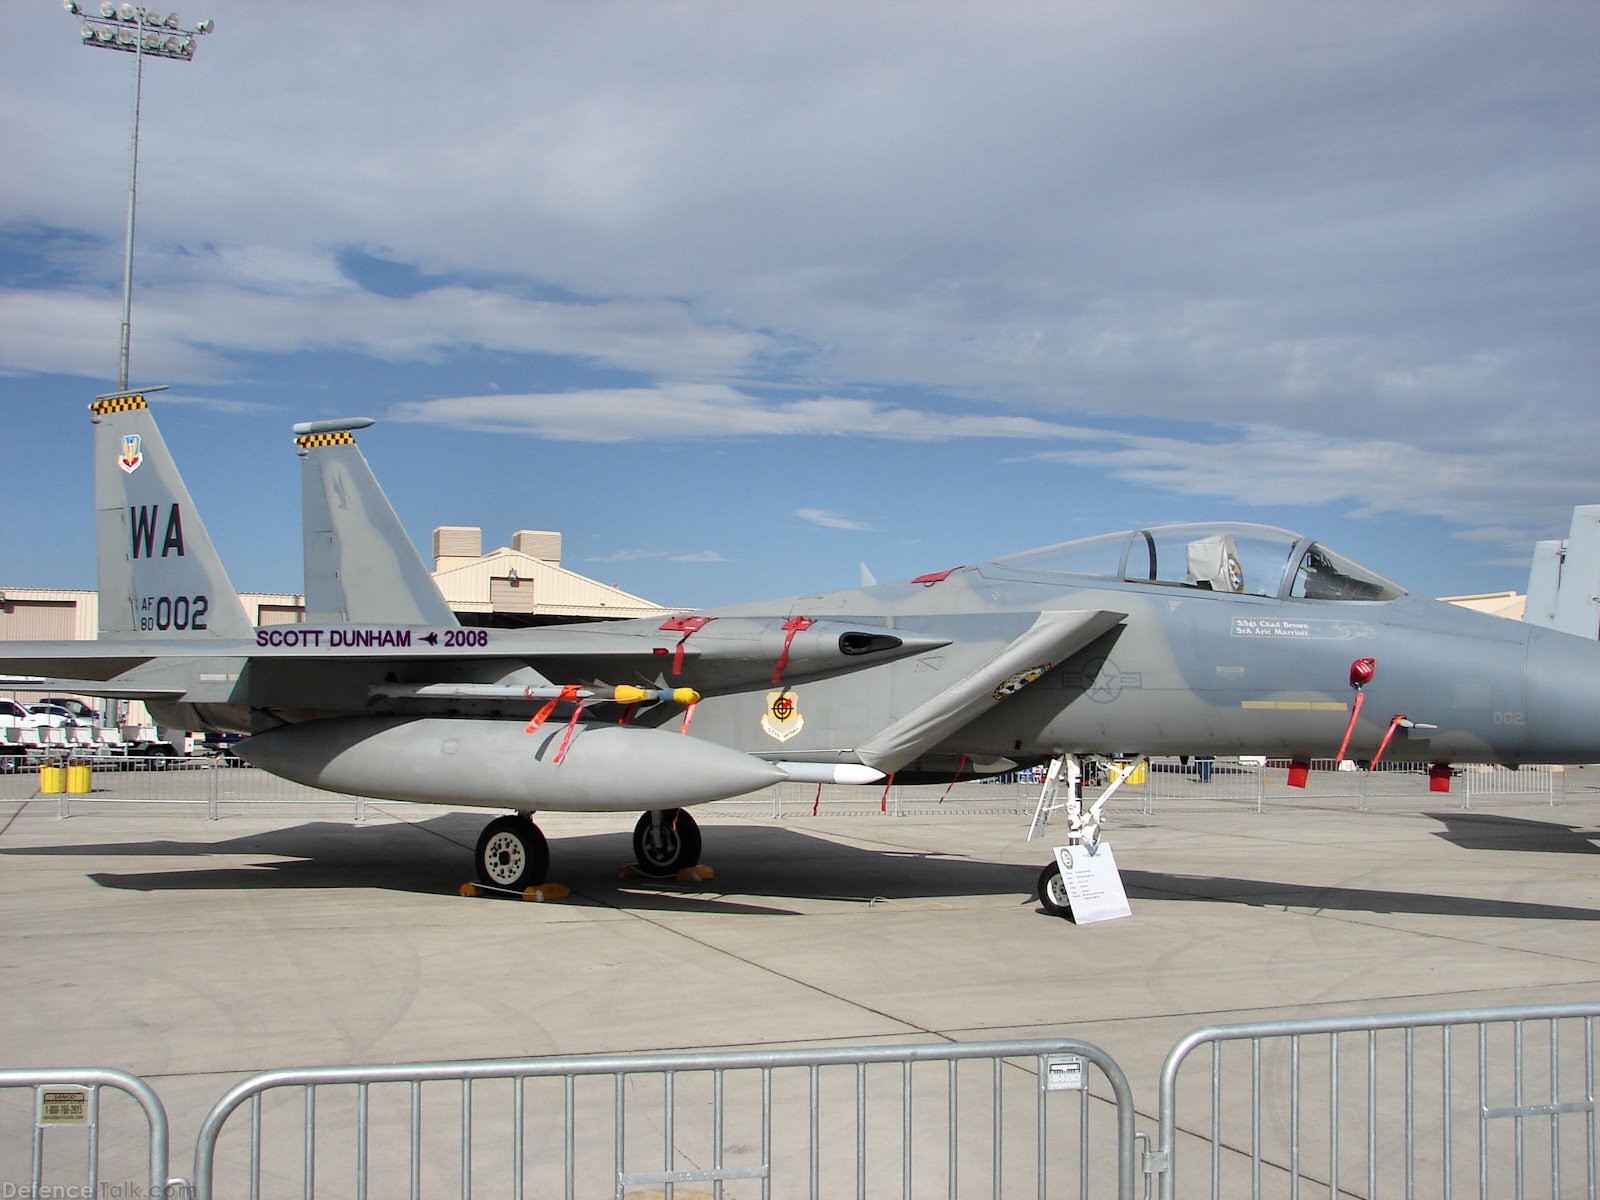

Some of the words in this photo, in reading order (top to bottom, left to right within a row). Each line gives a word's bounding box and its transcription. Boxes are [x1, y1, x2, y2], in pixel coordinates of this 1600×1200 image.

[131, 503, 184, 558] WA
[141, 597, 154, 611] AF
[156, 595, 208, 630] 002
[141, 617, 154, 630] 80
[1236, 619, 1257, 628] SSgt
[1259, 620, 1281, 628] Chad
[1282, 621, 1309, 629] Brown
[1236, 627, 1253, 635] SrA
[1274, 629, 1309, 637] Marriott
[1493, 711, 1525, 725] 002
